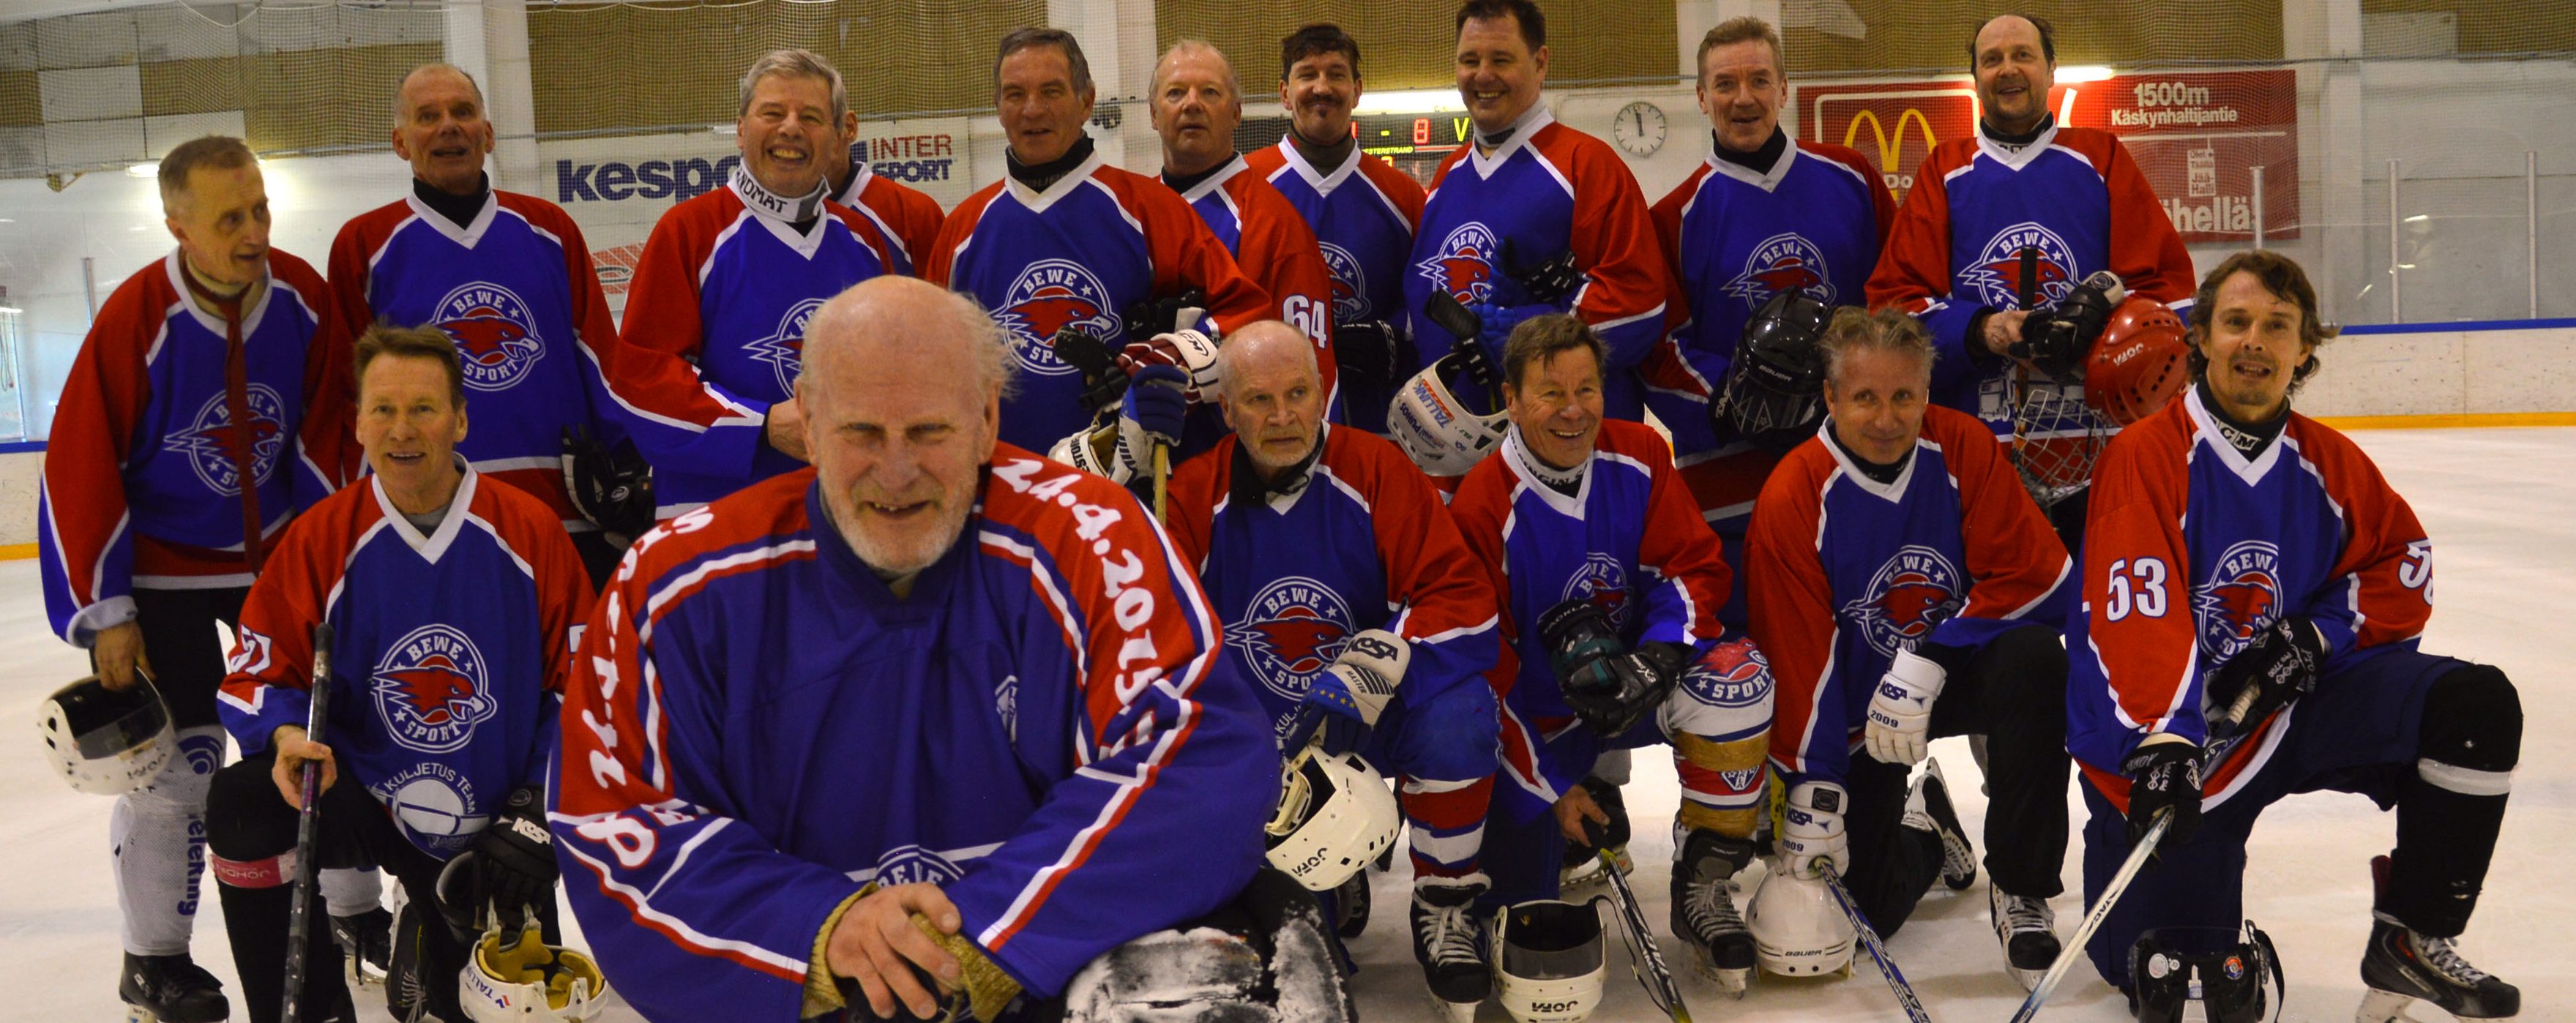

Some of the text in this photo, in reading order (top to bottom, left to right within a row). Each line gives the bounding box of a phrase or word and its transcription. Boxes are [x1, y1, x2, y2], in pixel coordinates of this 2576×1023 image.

[2134, 81, 2209, 107] 1500m
[2111, 106, 2238, 128] Käskynhaltijantie
[872, 134, 952, 160] INTER
[872, 159, 952, 182] SPORT
[1452, 231, 1485, 251] BEWE
[2000, 232, 2050, 254] BEWE
[1023, 269, 1078, 293] BEWE
[452, 291, 505, 313] BEWE
[1283, 295, 1327, 349] 64
[463, 359, 518, 381] SPORT
[1414, 383, 1450, 429] TALLINK
[992, 458, 1162, 705] 24.4.2015
[2105, 556, 2168, 622] 53
[1264, 587, 1322, 614] BEWE
[406, 635, 463, 662] BEWE
[1712, 665, 1770, 700] SPORT
[404, 720, 461, 742] SPORT
[1870, 709, 1899, 729] 2009
[384, 762, 476, 814] KULJETUS TEAM
[1291, 847, 1328, 877] JOFA
[1785, 948, 1823, 958] BAUER
[1531, 1000, 1579, 1013] JOFA
